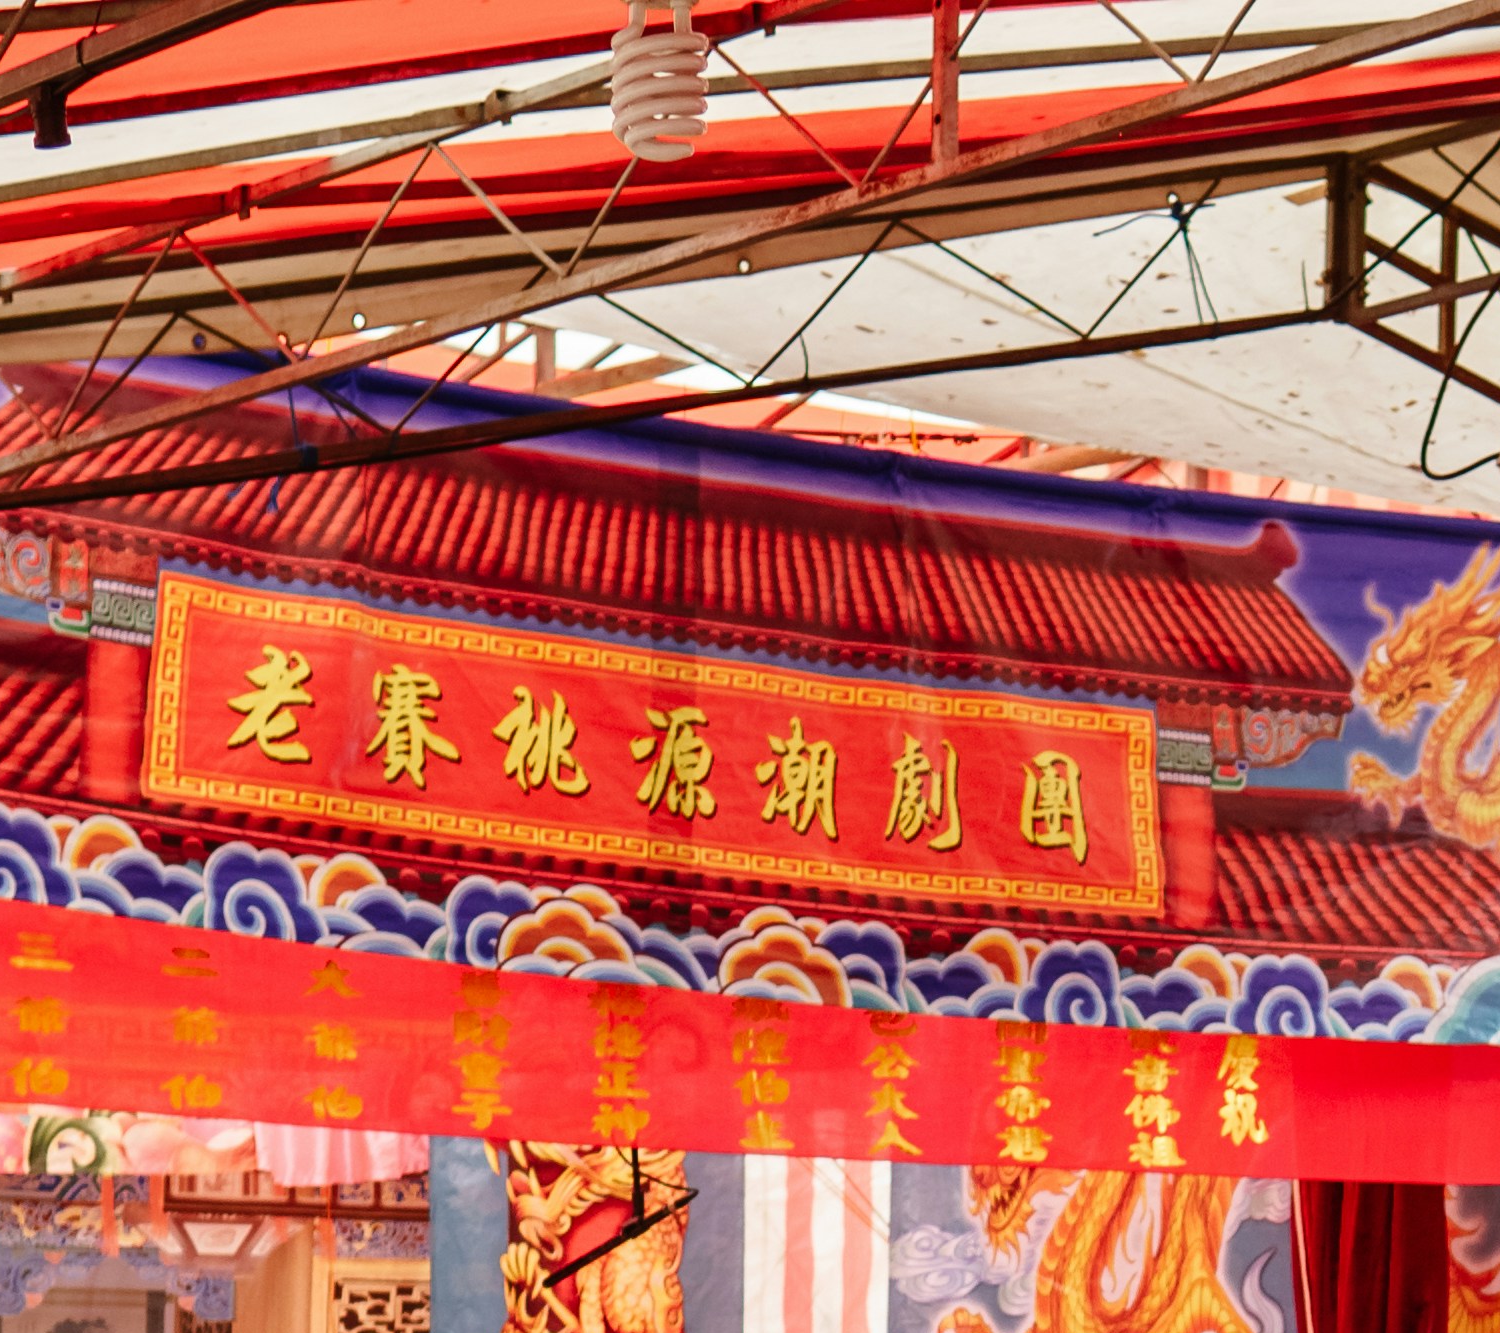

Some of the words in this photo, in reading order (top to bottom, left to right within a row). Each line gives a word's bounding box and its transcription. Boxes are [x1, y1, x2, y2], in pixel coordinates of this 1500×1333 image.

[225, 645, 1091, 863] 老賽桃源潮劇團
